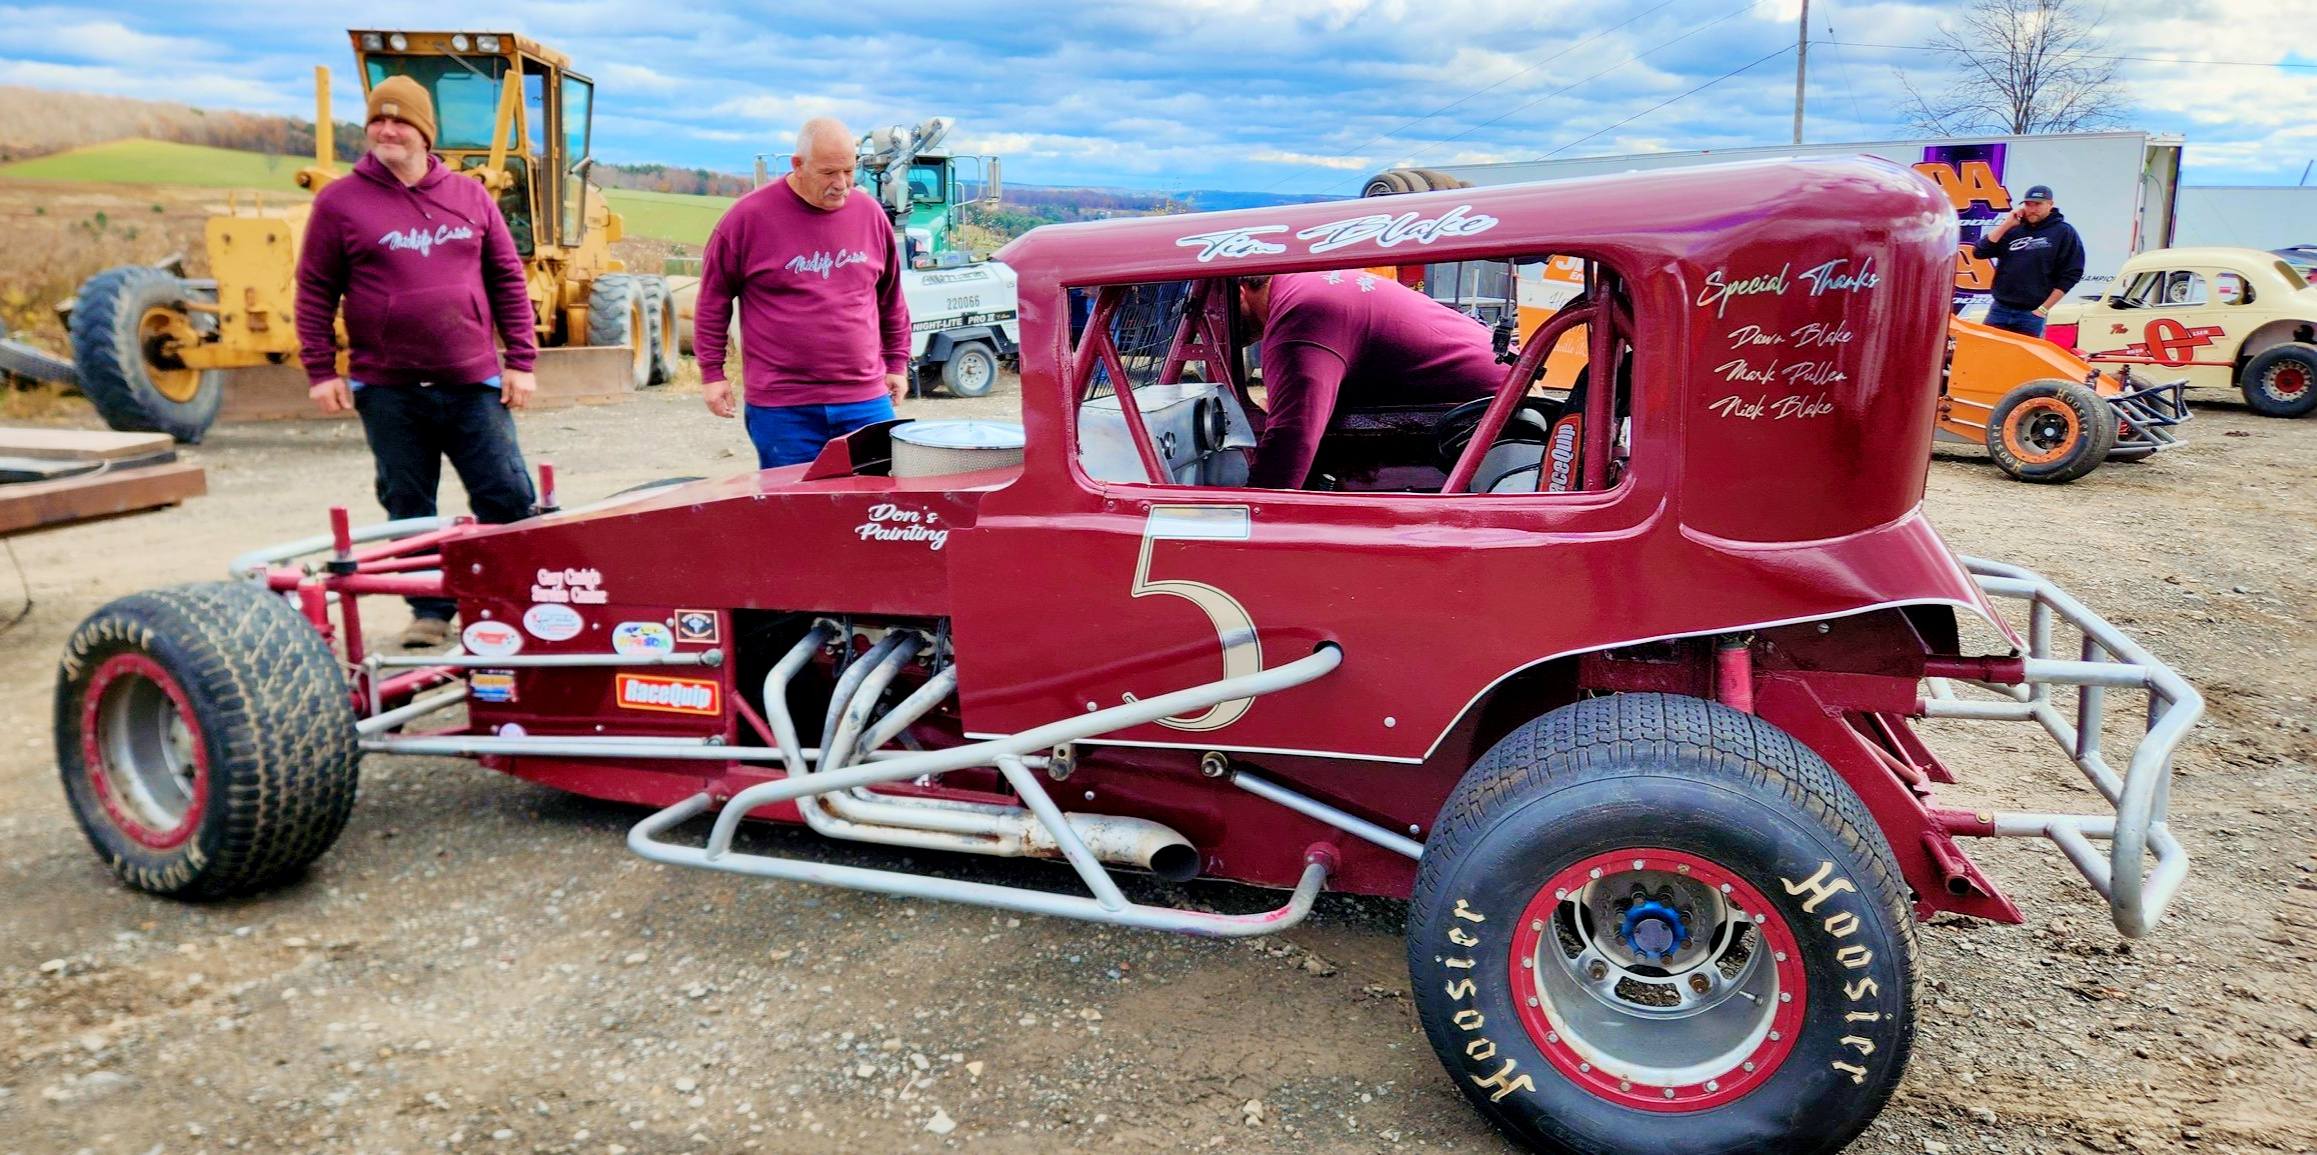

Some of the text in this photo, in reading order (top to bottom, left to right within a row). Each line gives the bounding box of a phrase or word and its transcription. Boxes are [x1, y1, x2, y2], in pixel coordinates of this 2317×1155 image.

[1176, 205, 1500, 262] Tim Blake
[1696, 256, 1881, 318] Special Thanks
[967, 313, 986, 325] PRO
[1728, 319, 1853, 349] Dawn Blake
[1714, 359, 1778, 385] Mark
[1708, 392, 1834, 420] Nick Blake
[1548, 424, 1576, 491] aceQuip
[868, 503, 939, 524] Don's
[854, 523, 949, 551] Painting
[1121, 504, 1263, 732] 5
[624, 678, 712, 709] RaceQuip
[1780, 861, 1894, 1085] Hoosier
[1434, 898, 1537, 1103] Hoosier
